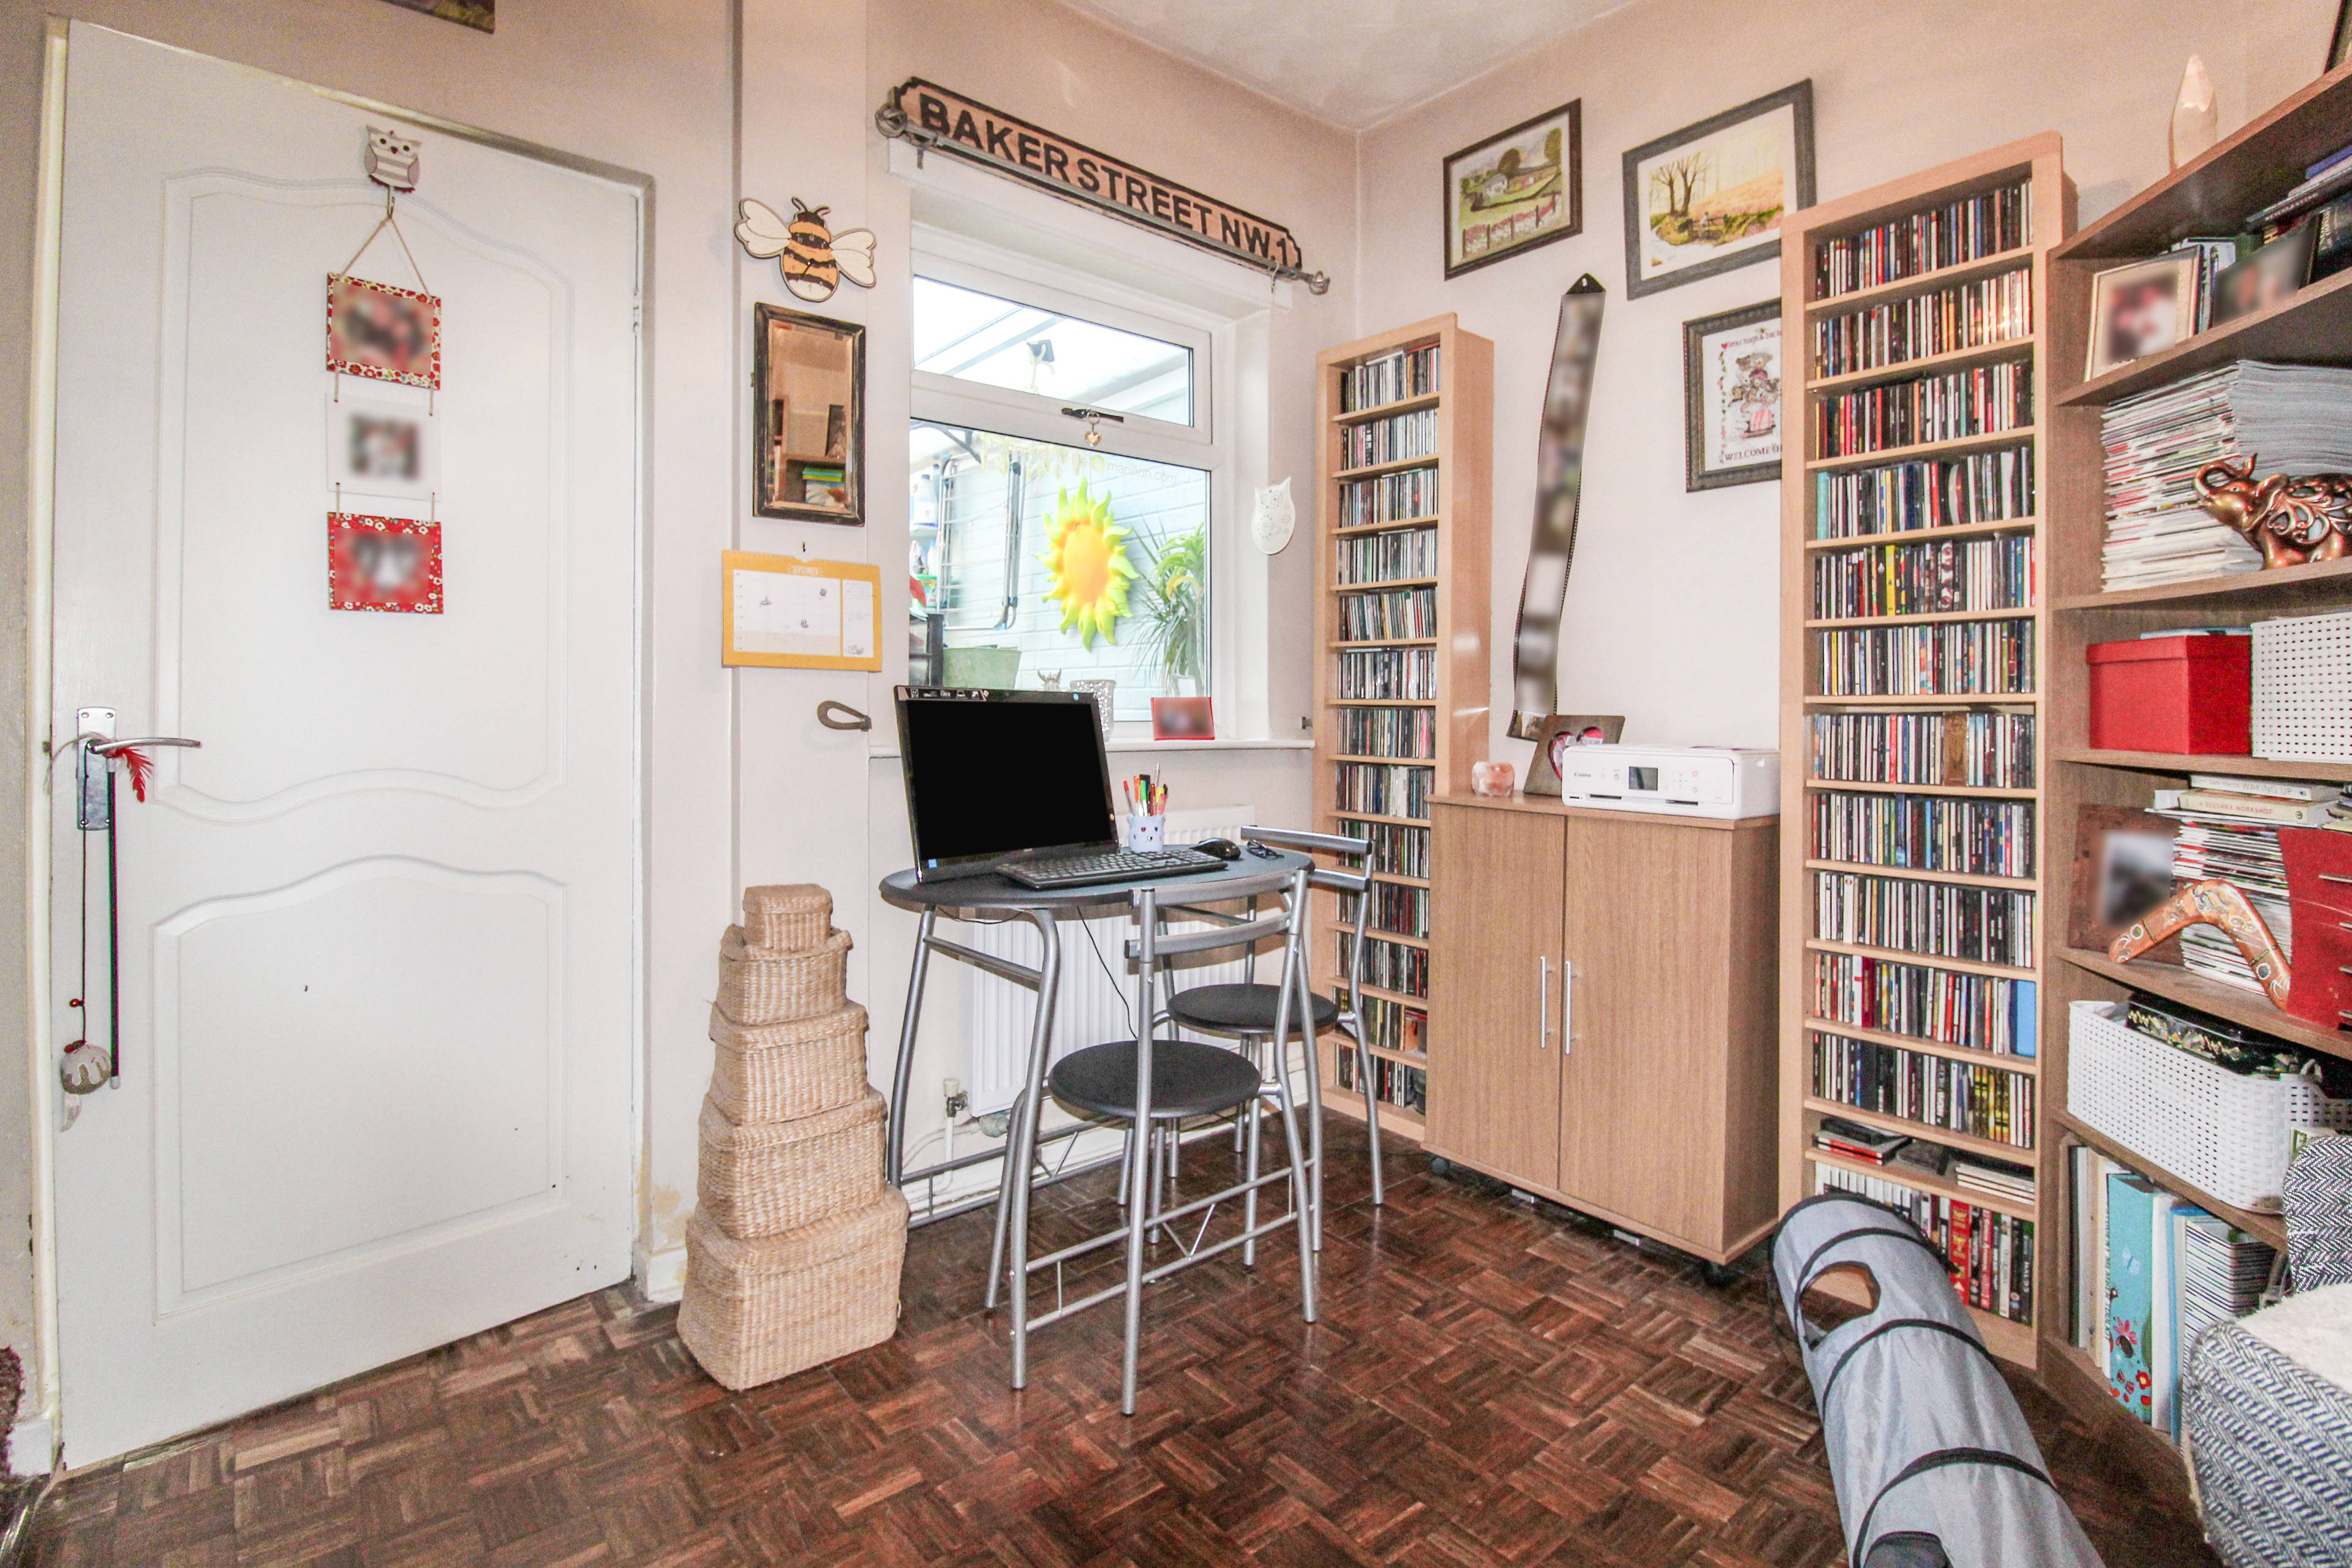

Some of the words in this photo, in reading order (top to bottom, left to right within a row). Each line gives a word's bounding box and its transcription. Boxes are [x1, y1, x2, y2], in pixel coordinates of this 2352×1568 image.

[919, 92, 1070, 184] BAKER
[1077, 157, 1213, 235] STREET
[1725, 447, 1771, 461] WELCOME
[1107, 461, 1177, 484] marillion.com
[2242, 783, 2278, 794] WAKING
[2235, 805, 2274, 815] WORKSHOP
